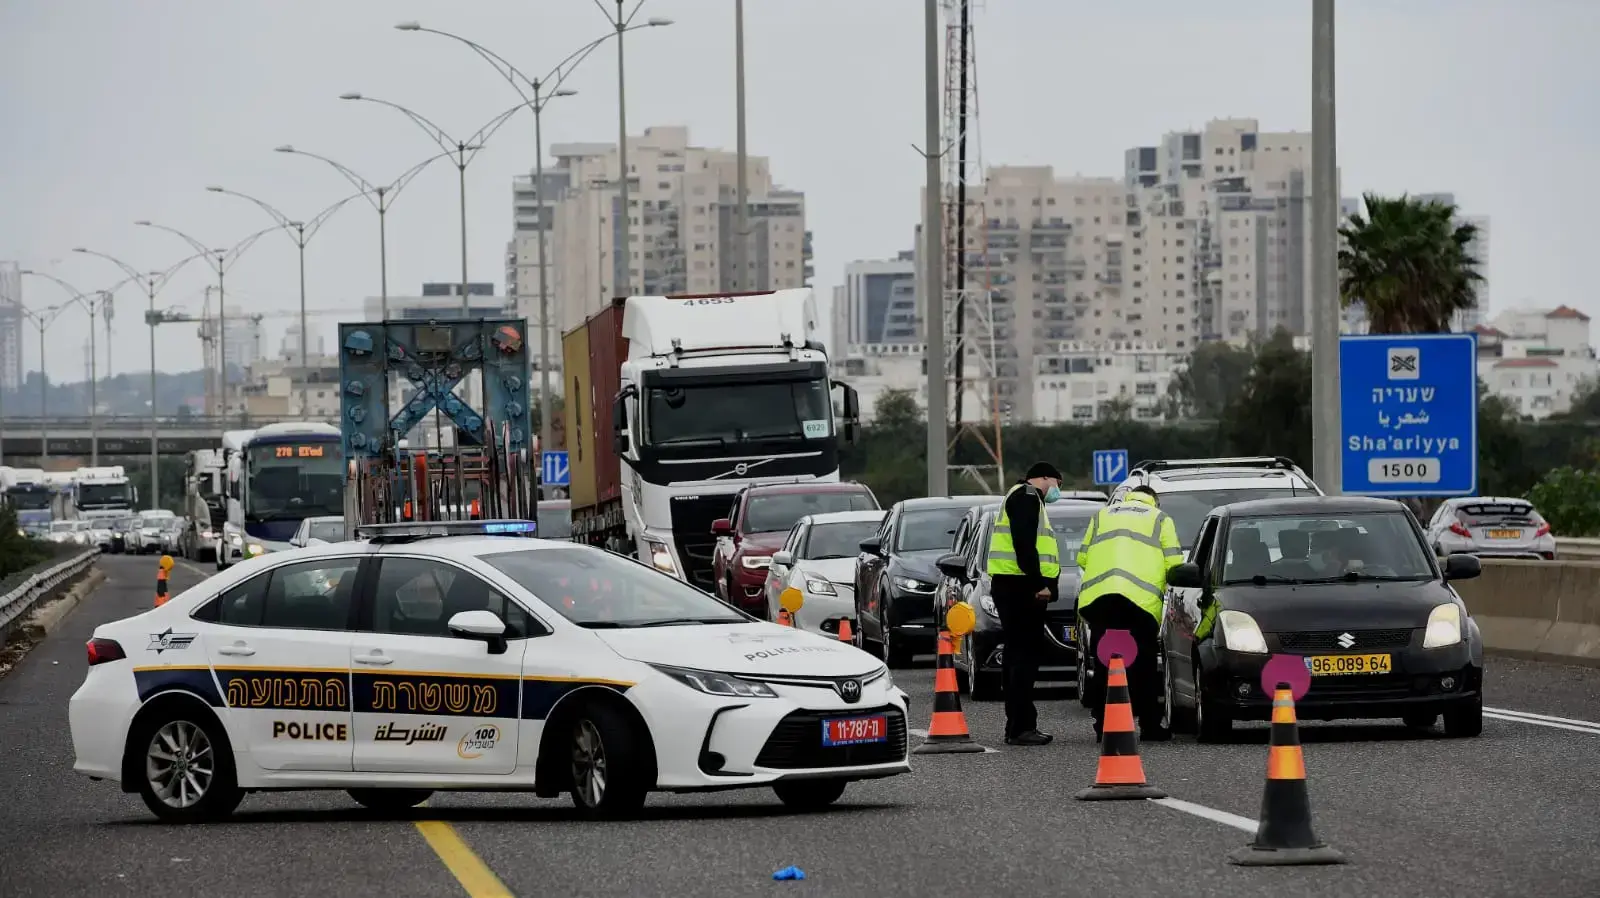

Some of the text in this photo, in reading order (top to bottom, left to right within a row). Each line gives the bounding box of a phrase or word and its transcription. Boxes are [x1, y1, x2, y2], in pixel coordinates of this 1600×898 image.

[1372, 387, 1435, 404] שעריה
[1348, 435, 1459, 454] Sha'ariyya
[1381, 463, 1427, 477] 1500
[744, 646, 799, 661] POLICE
[228, 678, 497, 714] משטרת התנועה
[273, 721, 347, 741] POLICE
[374, 721, 448, 746] الشرطة
[475, 728, 496, 740] 100
[463, 739, 495, 751] בשבילך
